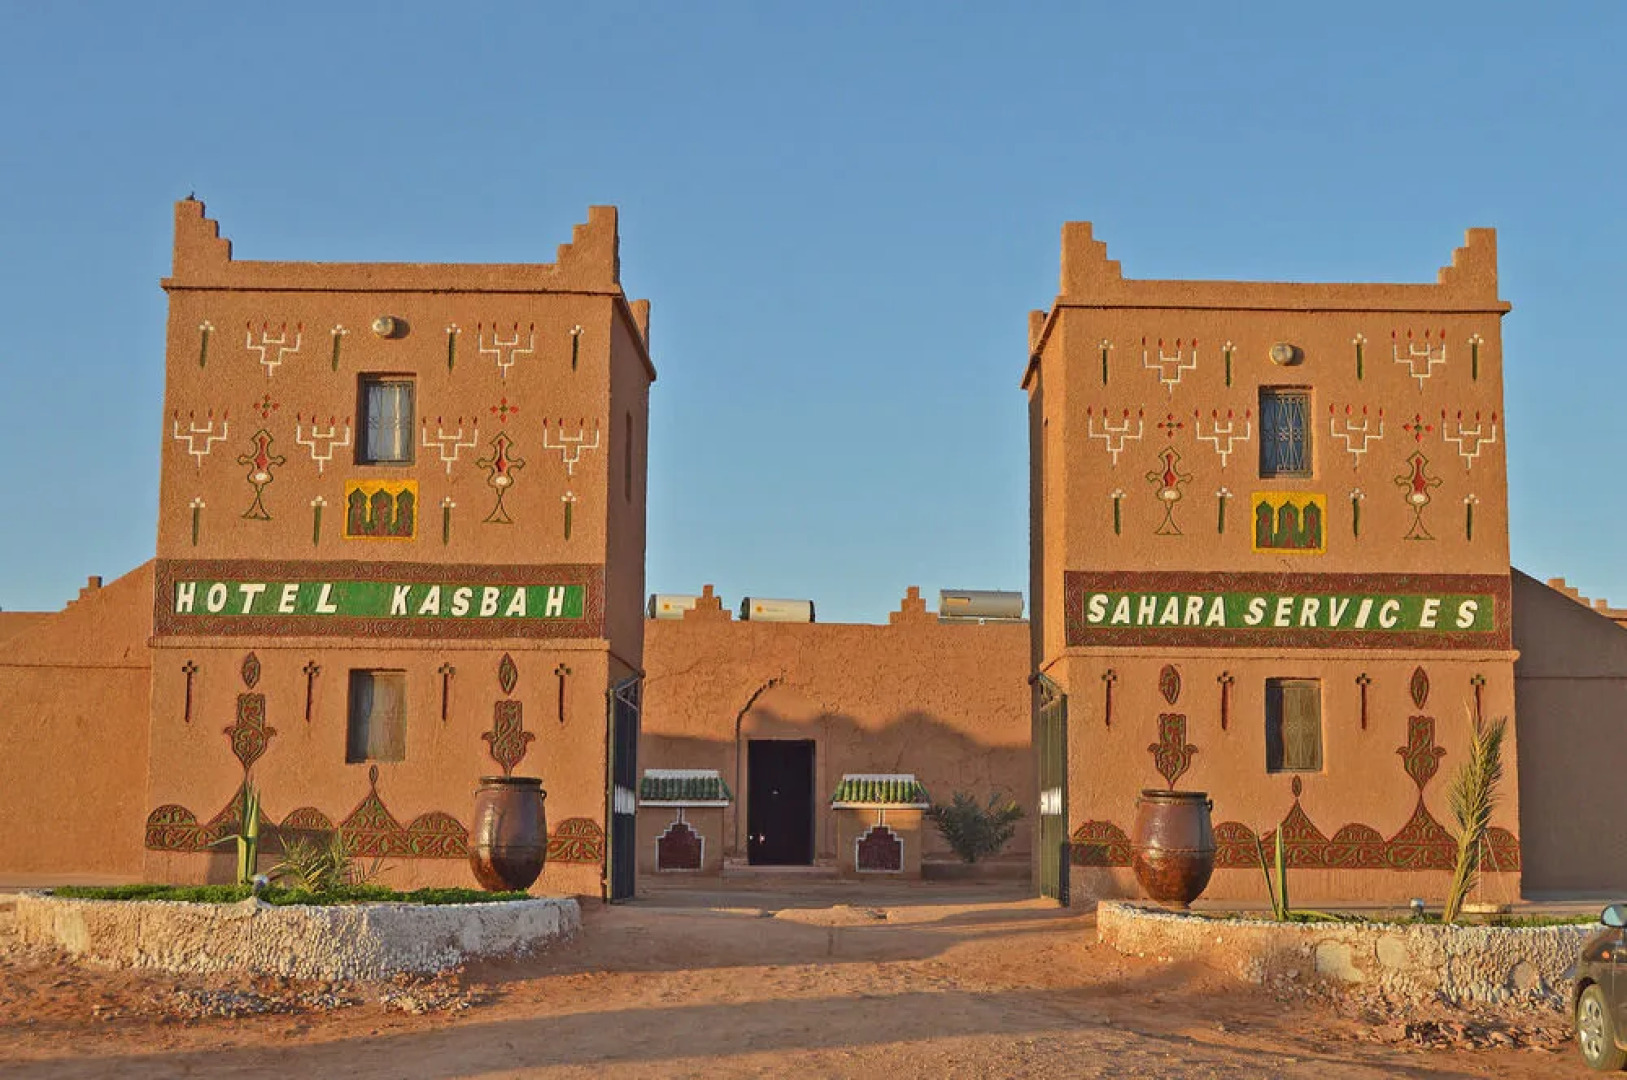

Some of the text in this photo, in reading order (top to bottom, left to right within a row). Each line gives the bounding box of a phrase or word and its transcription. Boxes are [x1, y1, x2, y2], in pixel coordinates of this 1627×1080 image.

[175, 581, 566, 618] HOTEL KASBAH
[1087, 593, 1479, 629] SAHARA SERVICES
